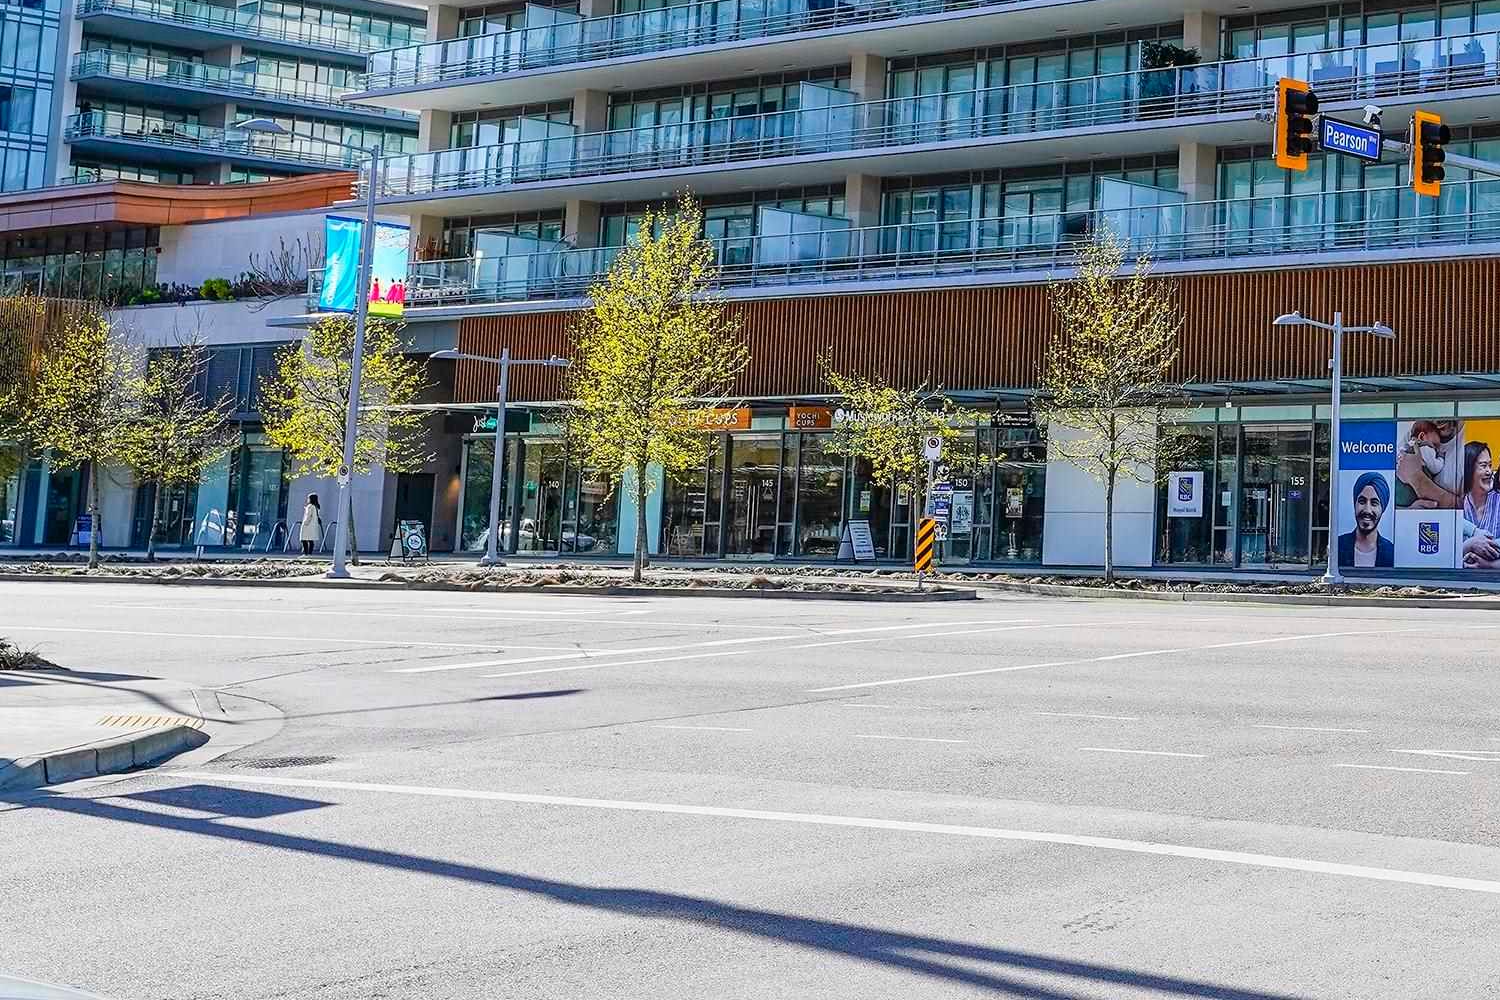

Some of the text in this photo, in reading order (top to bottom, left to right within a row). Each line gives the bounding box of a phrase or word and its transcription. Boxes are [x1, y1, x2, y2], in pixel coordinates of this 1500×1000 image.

[1326, 124, 1368, 152] Pearson
[797, 412, 820, 420] YOCHI
[1341, 440, 1394, 454] Welcome
[762, 479, 774, 488] 145
[955, 478, 968, 487] 150
[1290, 476, 1305, 486] 155
[1420, 544, 1438, 553] RBC
